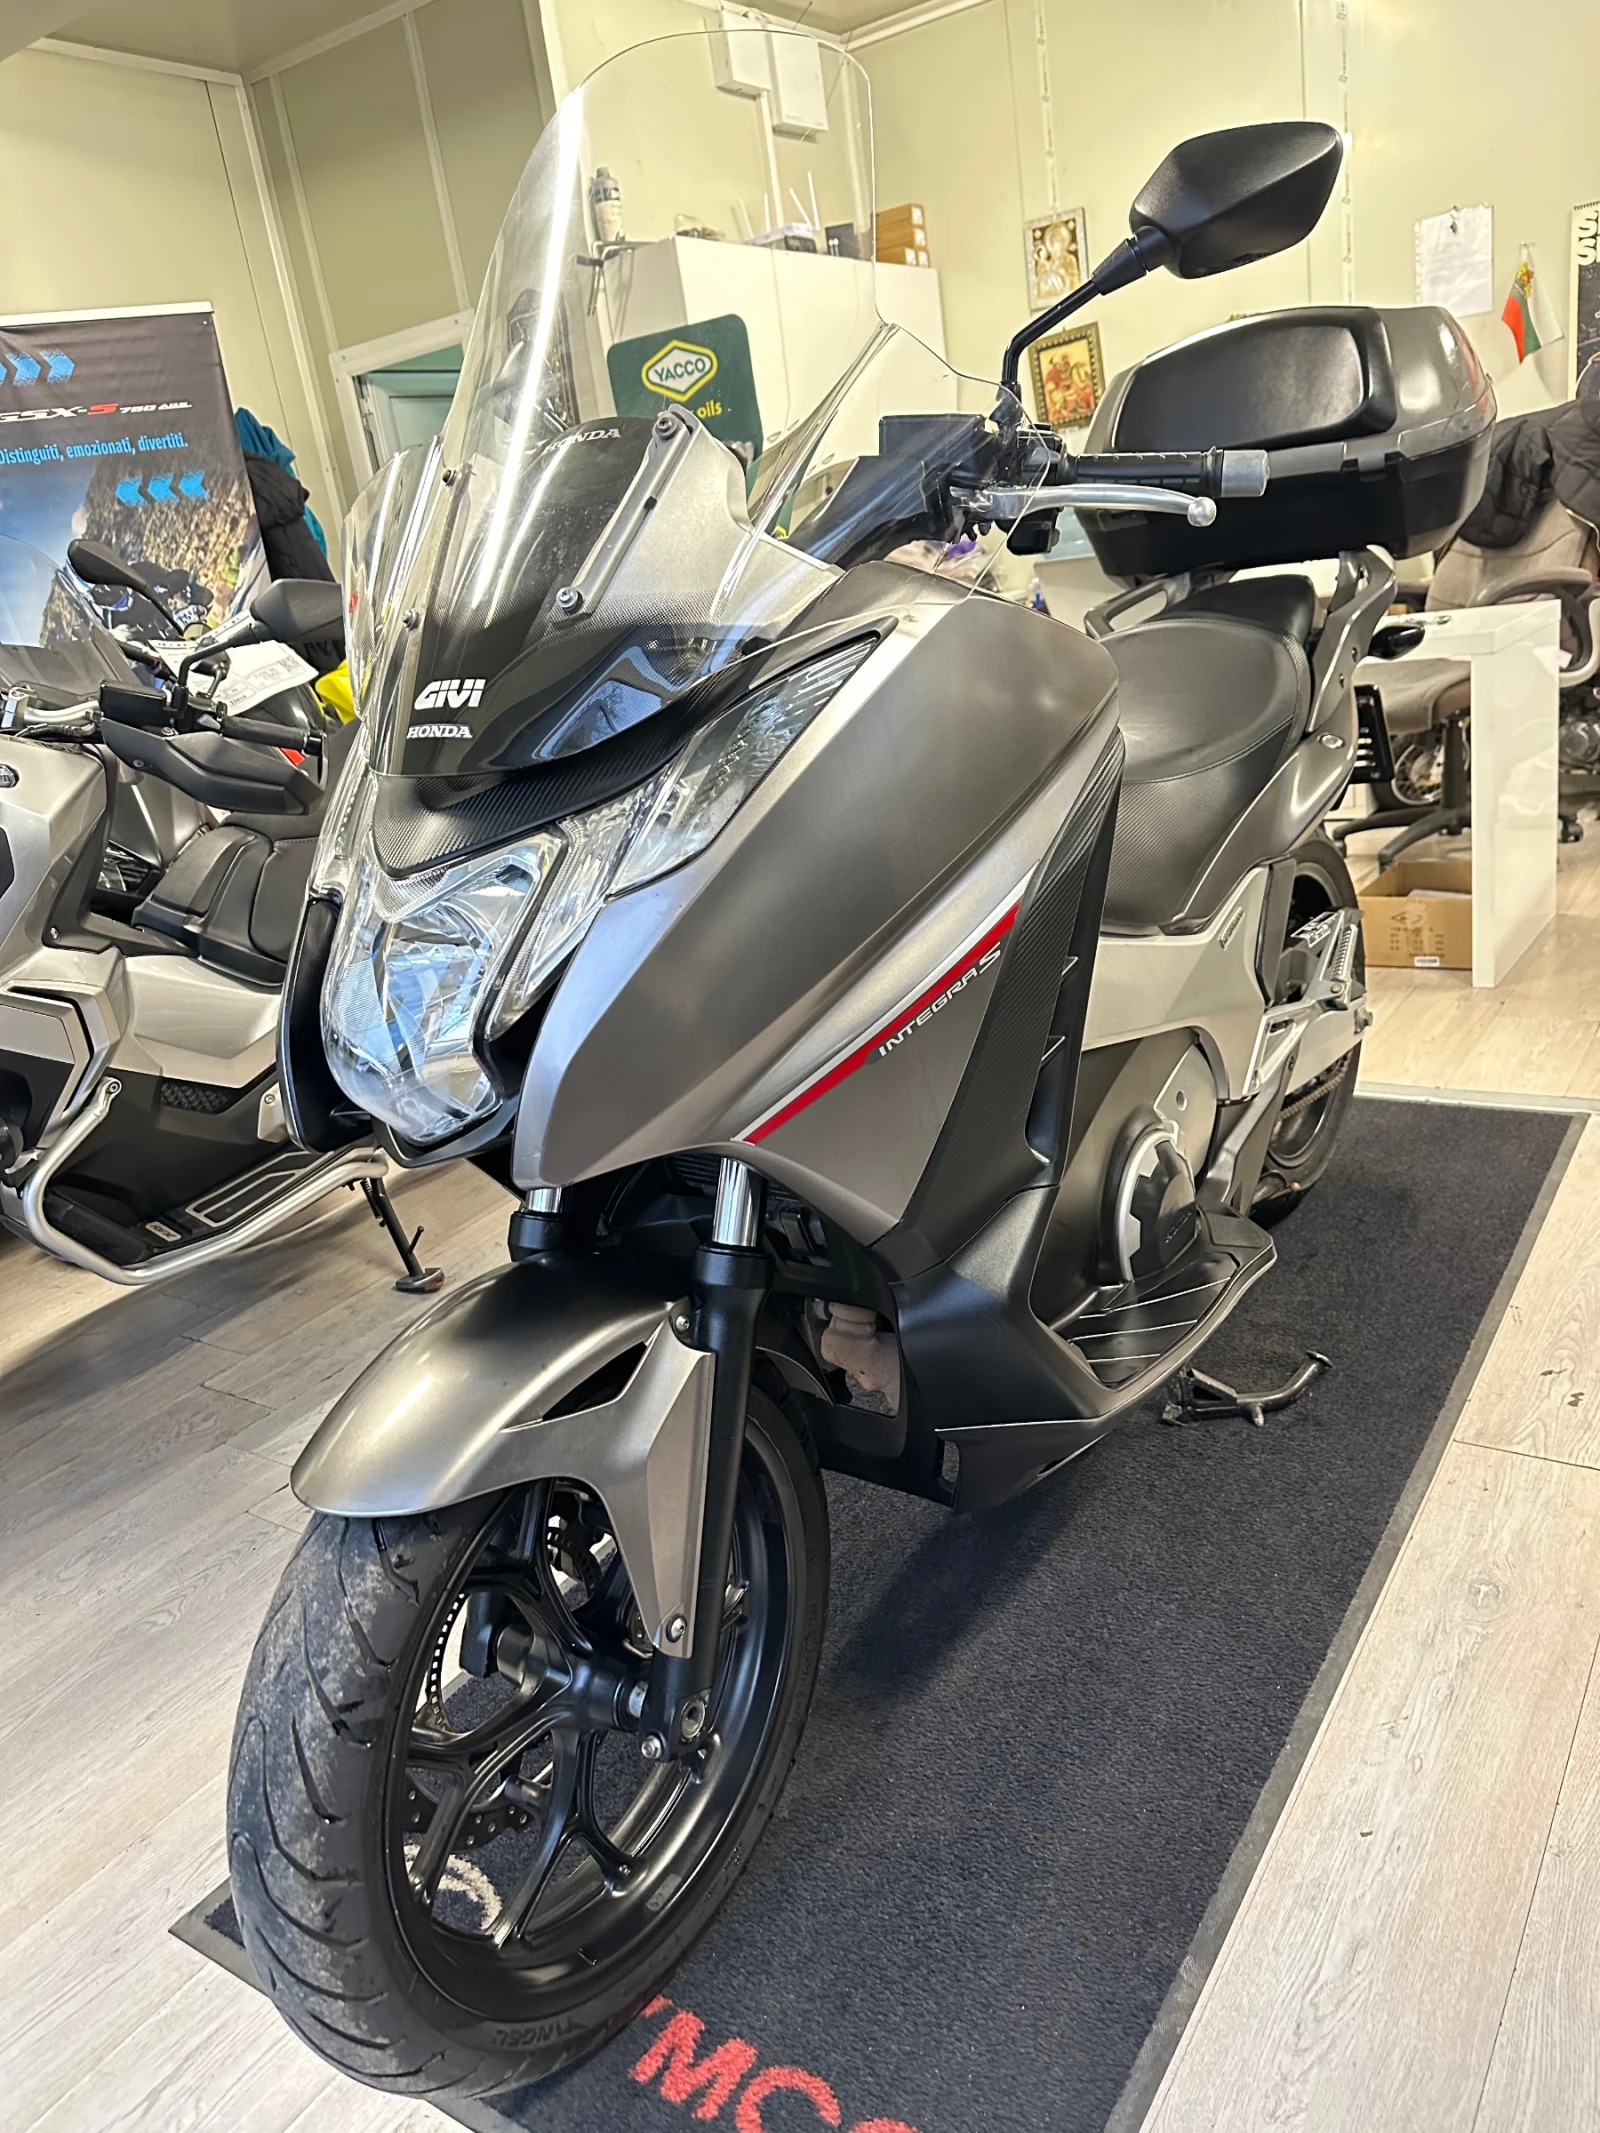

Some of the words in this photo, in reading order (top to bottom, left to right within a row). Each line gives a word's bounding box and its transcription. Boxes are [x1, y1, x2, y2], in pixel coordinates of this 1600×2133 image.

[653, 357, 707, 382] YACCO
[696, 400, 723, 419] oils
[0, 444, 65, 465] Distinguiti,
[66, 437, 136, 458] emozionati,
[138, 432, 189, 452] divertiti.
[414, 678, 487, 711] GIVI
[406, 724, 473, 740] HONDA
[879, 967, 978, 1057] INTEGRA
[979, 941, 1001, 974] S
